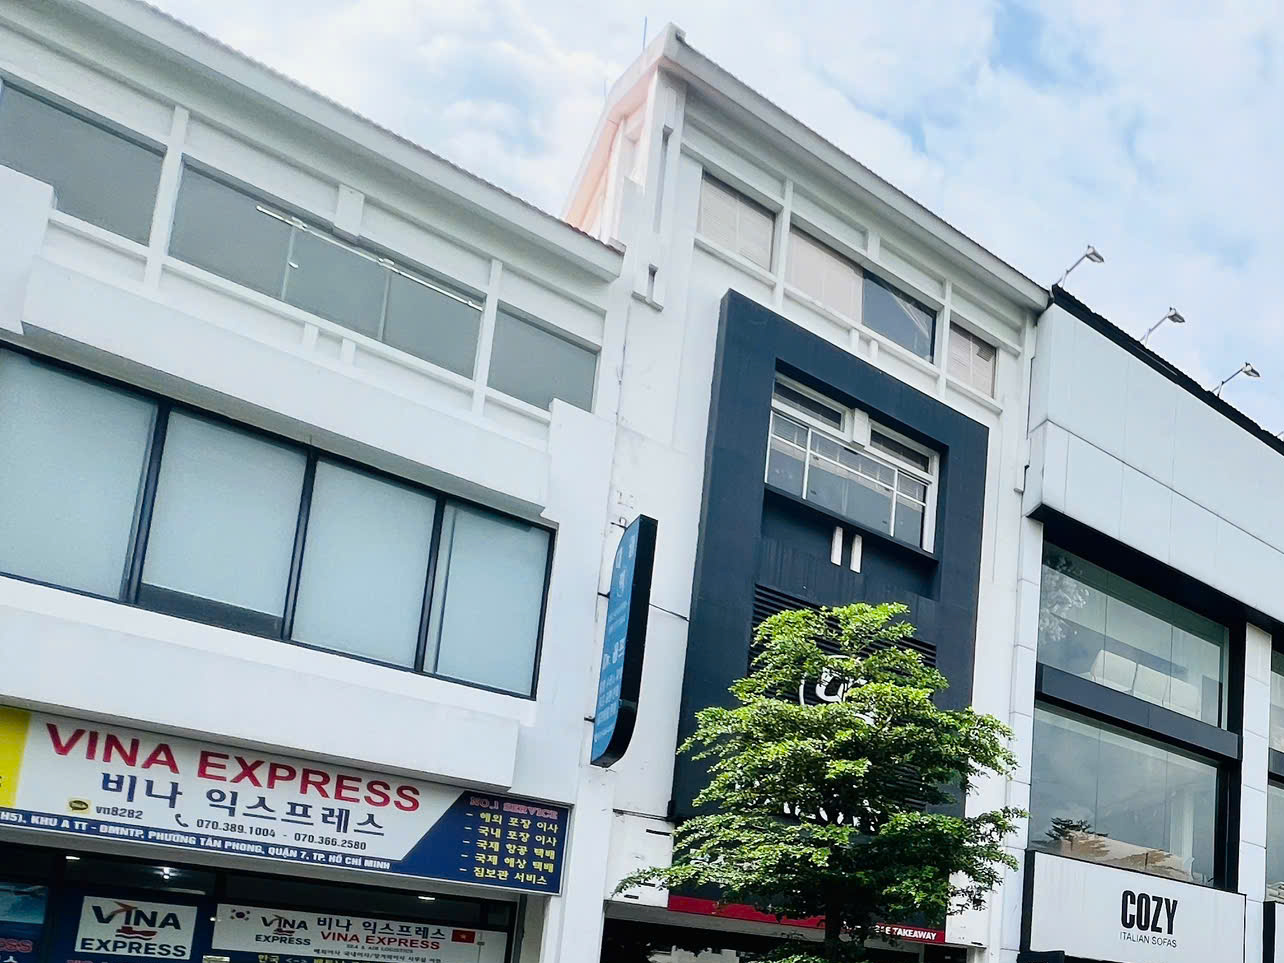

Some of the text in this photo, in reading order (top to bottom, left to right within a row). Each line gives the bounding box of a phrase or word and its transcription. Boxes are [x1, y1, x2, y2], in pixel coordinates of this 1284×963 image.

[46, 722, 420, 812] VINA EXPRESS
[101, 772, 384, 837] 비나 익스프레스
[503, 802, 558, 820] SERVICE
[95, 805, 143, 820] vn8282
[196, 818, 276, 838] 070.389.1004
[294, 832, 367, 850] 070.366.2580
[508, 817, 531, 829] 포장
[536, 821, 558, 833] 이사
[30, 815, 57, 827] KHU
[61, 819, 70, 830] A
[73, 820, 89, 831] TT
[268, 845, 298, 860] QUẬN
[345, 856, 361, 867] CHÍ
[364, 859, 390, 870] MINH
[477, 825, 556, 847] 국내 포장 이사
[514, 872, 547, 885] 서비스
[92, 905, 182, 930] VINA
[1121, 890, 1178, 935] COZY
[260, 915, 309, 931] VINA
[317, 917, 446, 940] 비나 익스프레스
[255, 934, 311, 946] EXPRESS
[320, 931, 440, 950] VINA EXPRESS
[893, 927, 937, 941] TAKEAWAY
[1120, 931, 1177, 948] ITALIAN SOFAS
[80, 937, 187, 958] EXPRESS
[258, 954, 280, 963] 한국
